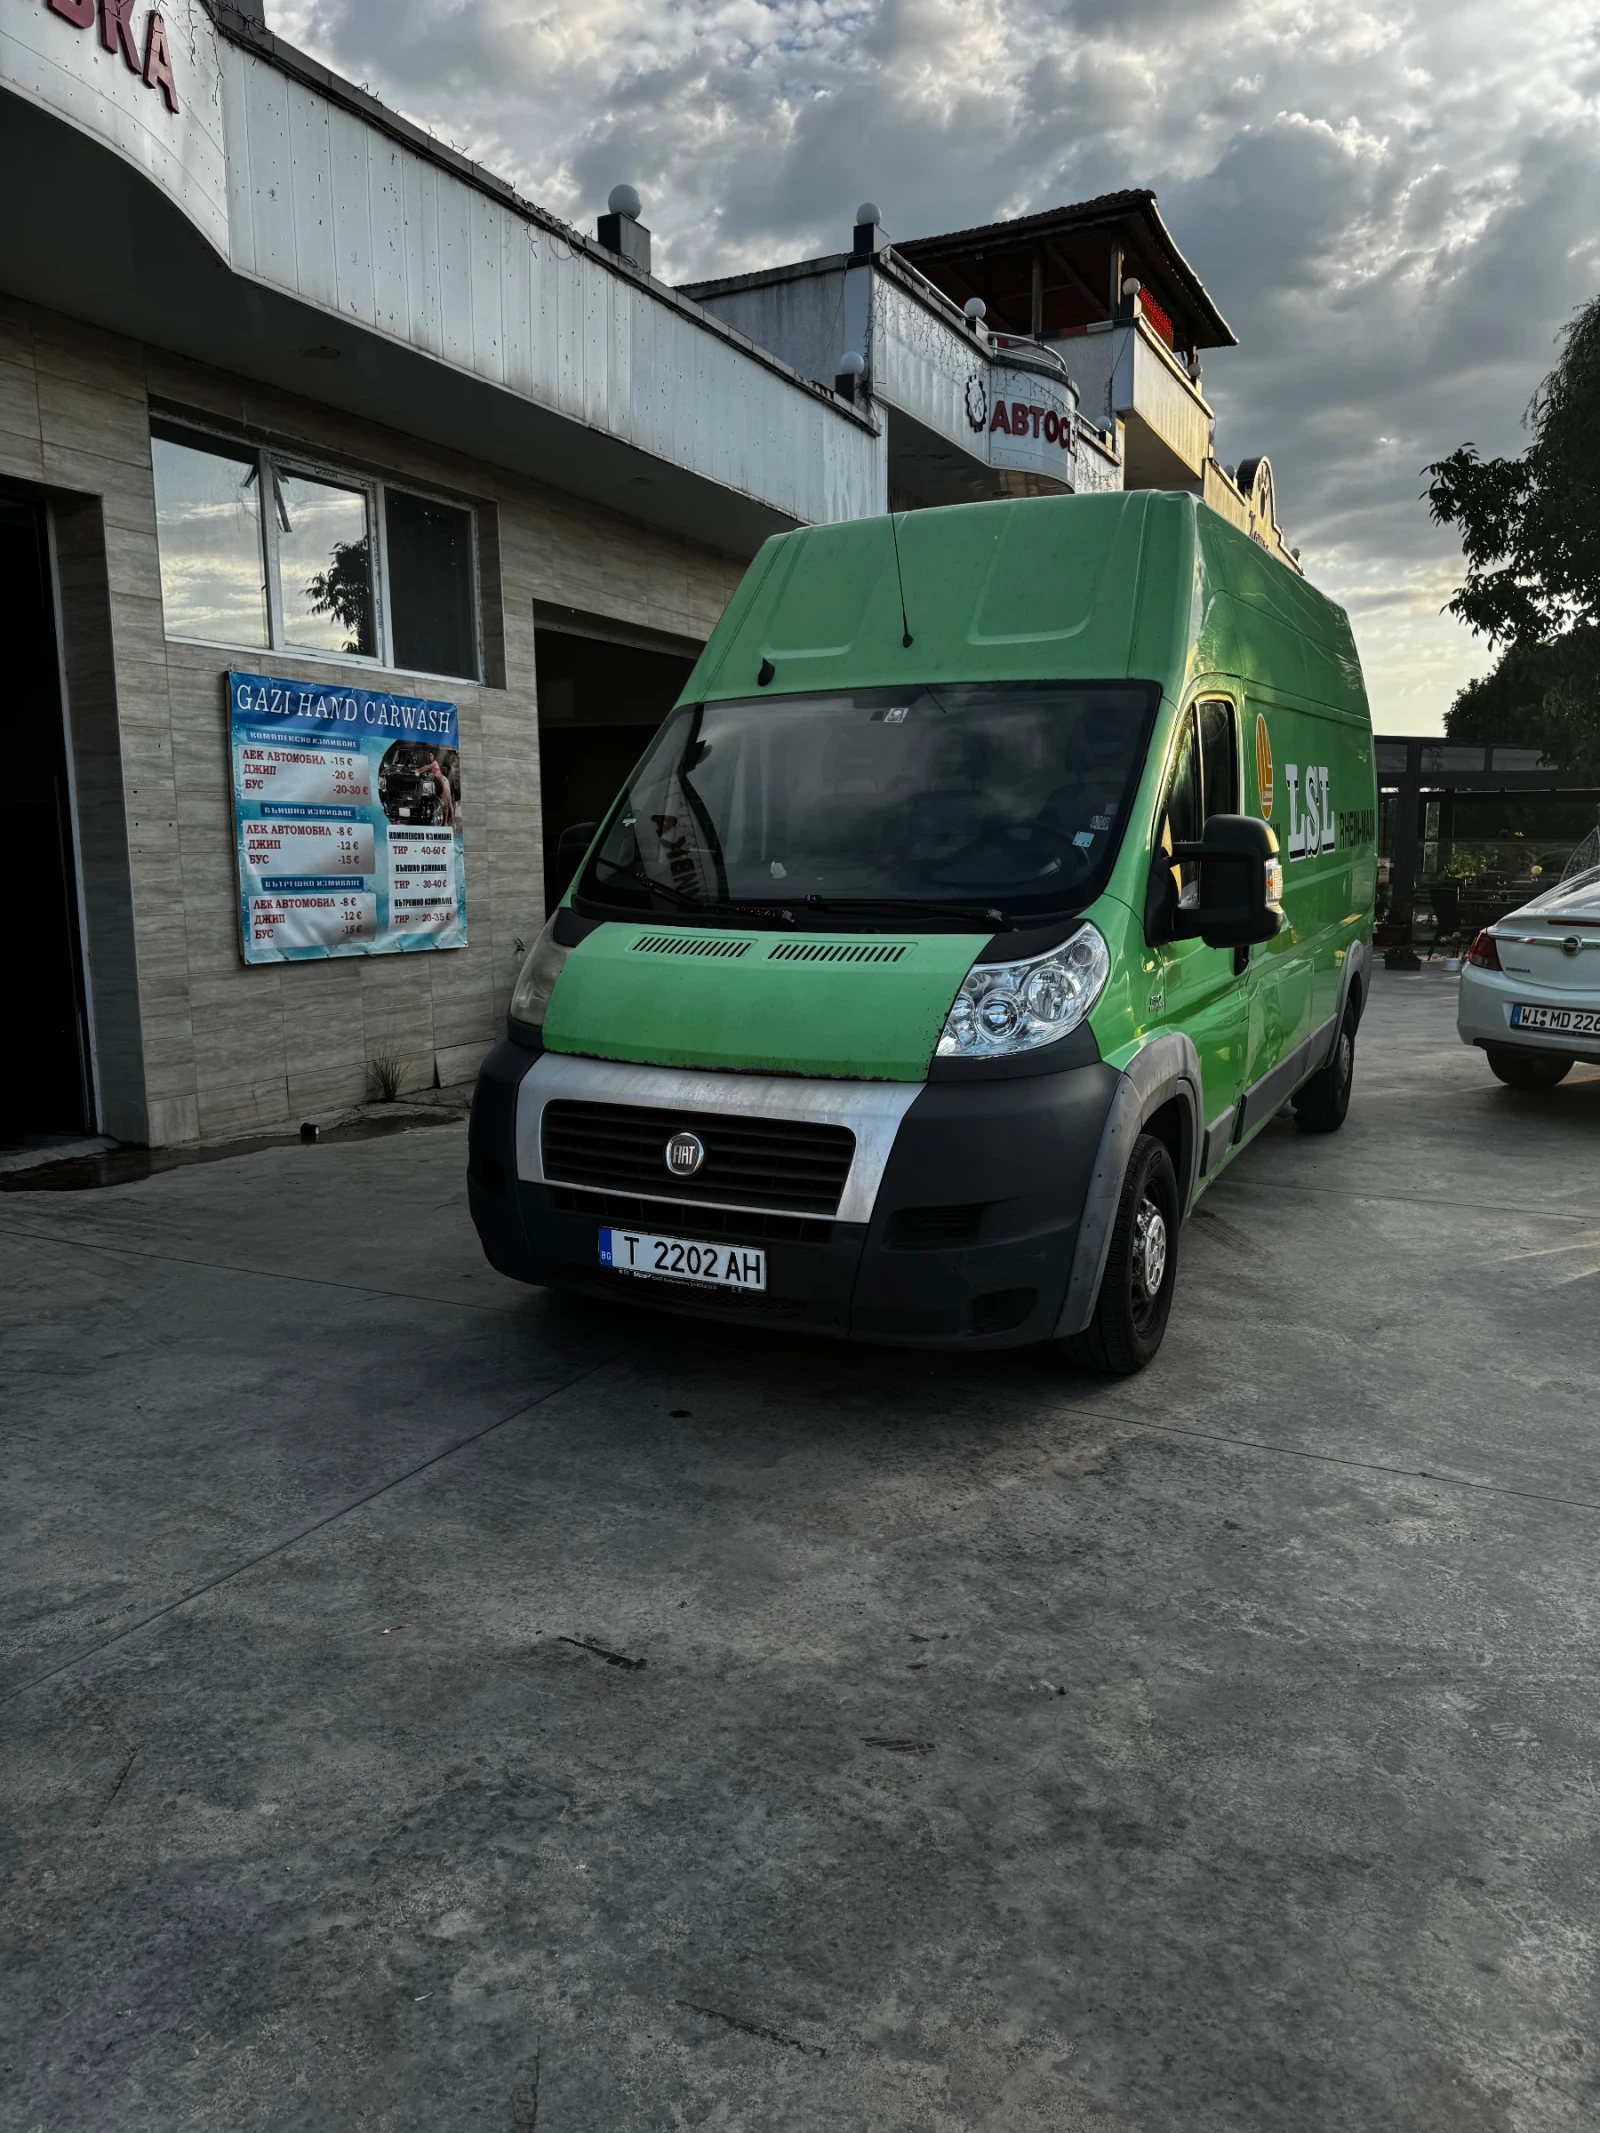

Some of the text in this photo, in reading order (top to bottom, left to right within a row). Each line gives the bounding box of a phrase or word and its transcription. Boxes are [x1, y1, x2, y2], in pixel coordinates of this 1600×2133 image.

[990, 400, 1077, 462] АВТОС
[236, 684, 450, 734] GAZI HAND CARWASH
[250, 732, 310, 744] КОМПЛЕКСНО
[242, 749, 264, 761] ЛЕК
[267, 752, 326, 765] АВТОМОБИЛ
[330, 757, 345, 765] -15
[243, 764, 277, 775] ДЖИП
[332, 770, 346, 780] -20
[245, 779, 264, 790] БУС
[333, 785, 360, 795] -20-30
[307, 808, 352, 817] ИЗМИВАНЕ
[1284, 764, 1336, 862] LSL
[246, 824, 268, 834] ЛЕК
[271, 825, 332, 836] АВТОМОБИЛ
[336, 827, 345, 836] -8
[248, 840, 281, 850] ДЖИП
[337, 841, 351, 850] -12
[392, 846, 409, 855] ТИР
[249, 855, 269, 865] БУС
[338, 856, 352, 864] -15
[265, 879, 360, 888] ВЪТРЕШНО ИЗМИВАНЕ
[394, 880, 410, 889] ТИР
[254, 899, 274, 909] ЛЕК
[276, 898, 336, 909] АВТОМОБИЛ
[340, 897, 350, 907] -8
[254, 914, 286, 925] ДЖИП
[340, 912, 355, 920] -12
[394, 915, 409, 924] ТИР
[254, 929, 274, 940] БУС
[342, 925, 355, 935] -15
[1522, 1008, 1538, 1025] WI
[1550, 1012, 1571, 1028] MD
[672, 1144, 695, 1165] FIAT
[601, 1251, 612, 1260] BG
[624, 1236, 640, 1265] T
[653, 1241, 718, 1278] 2202
[725, 1252, 761, 1284] AH
